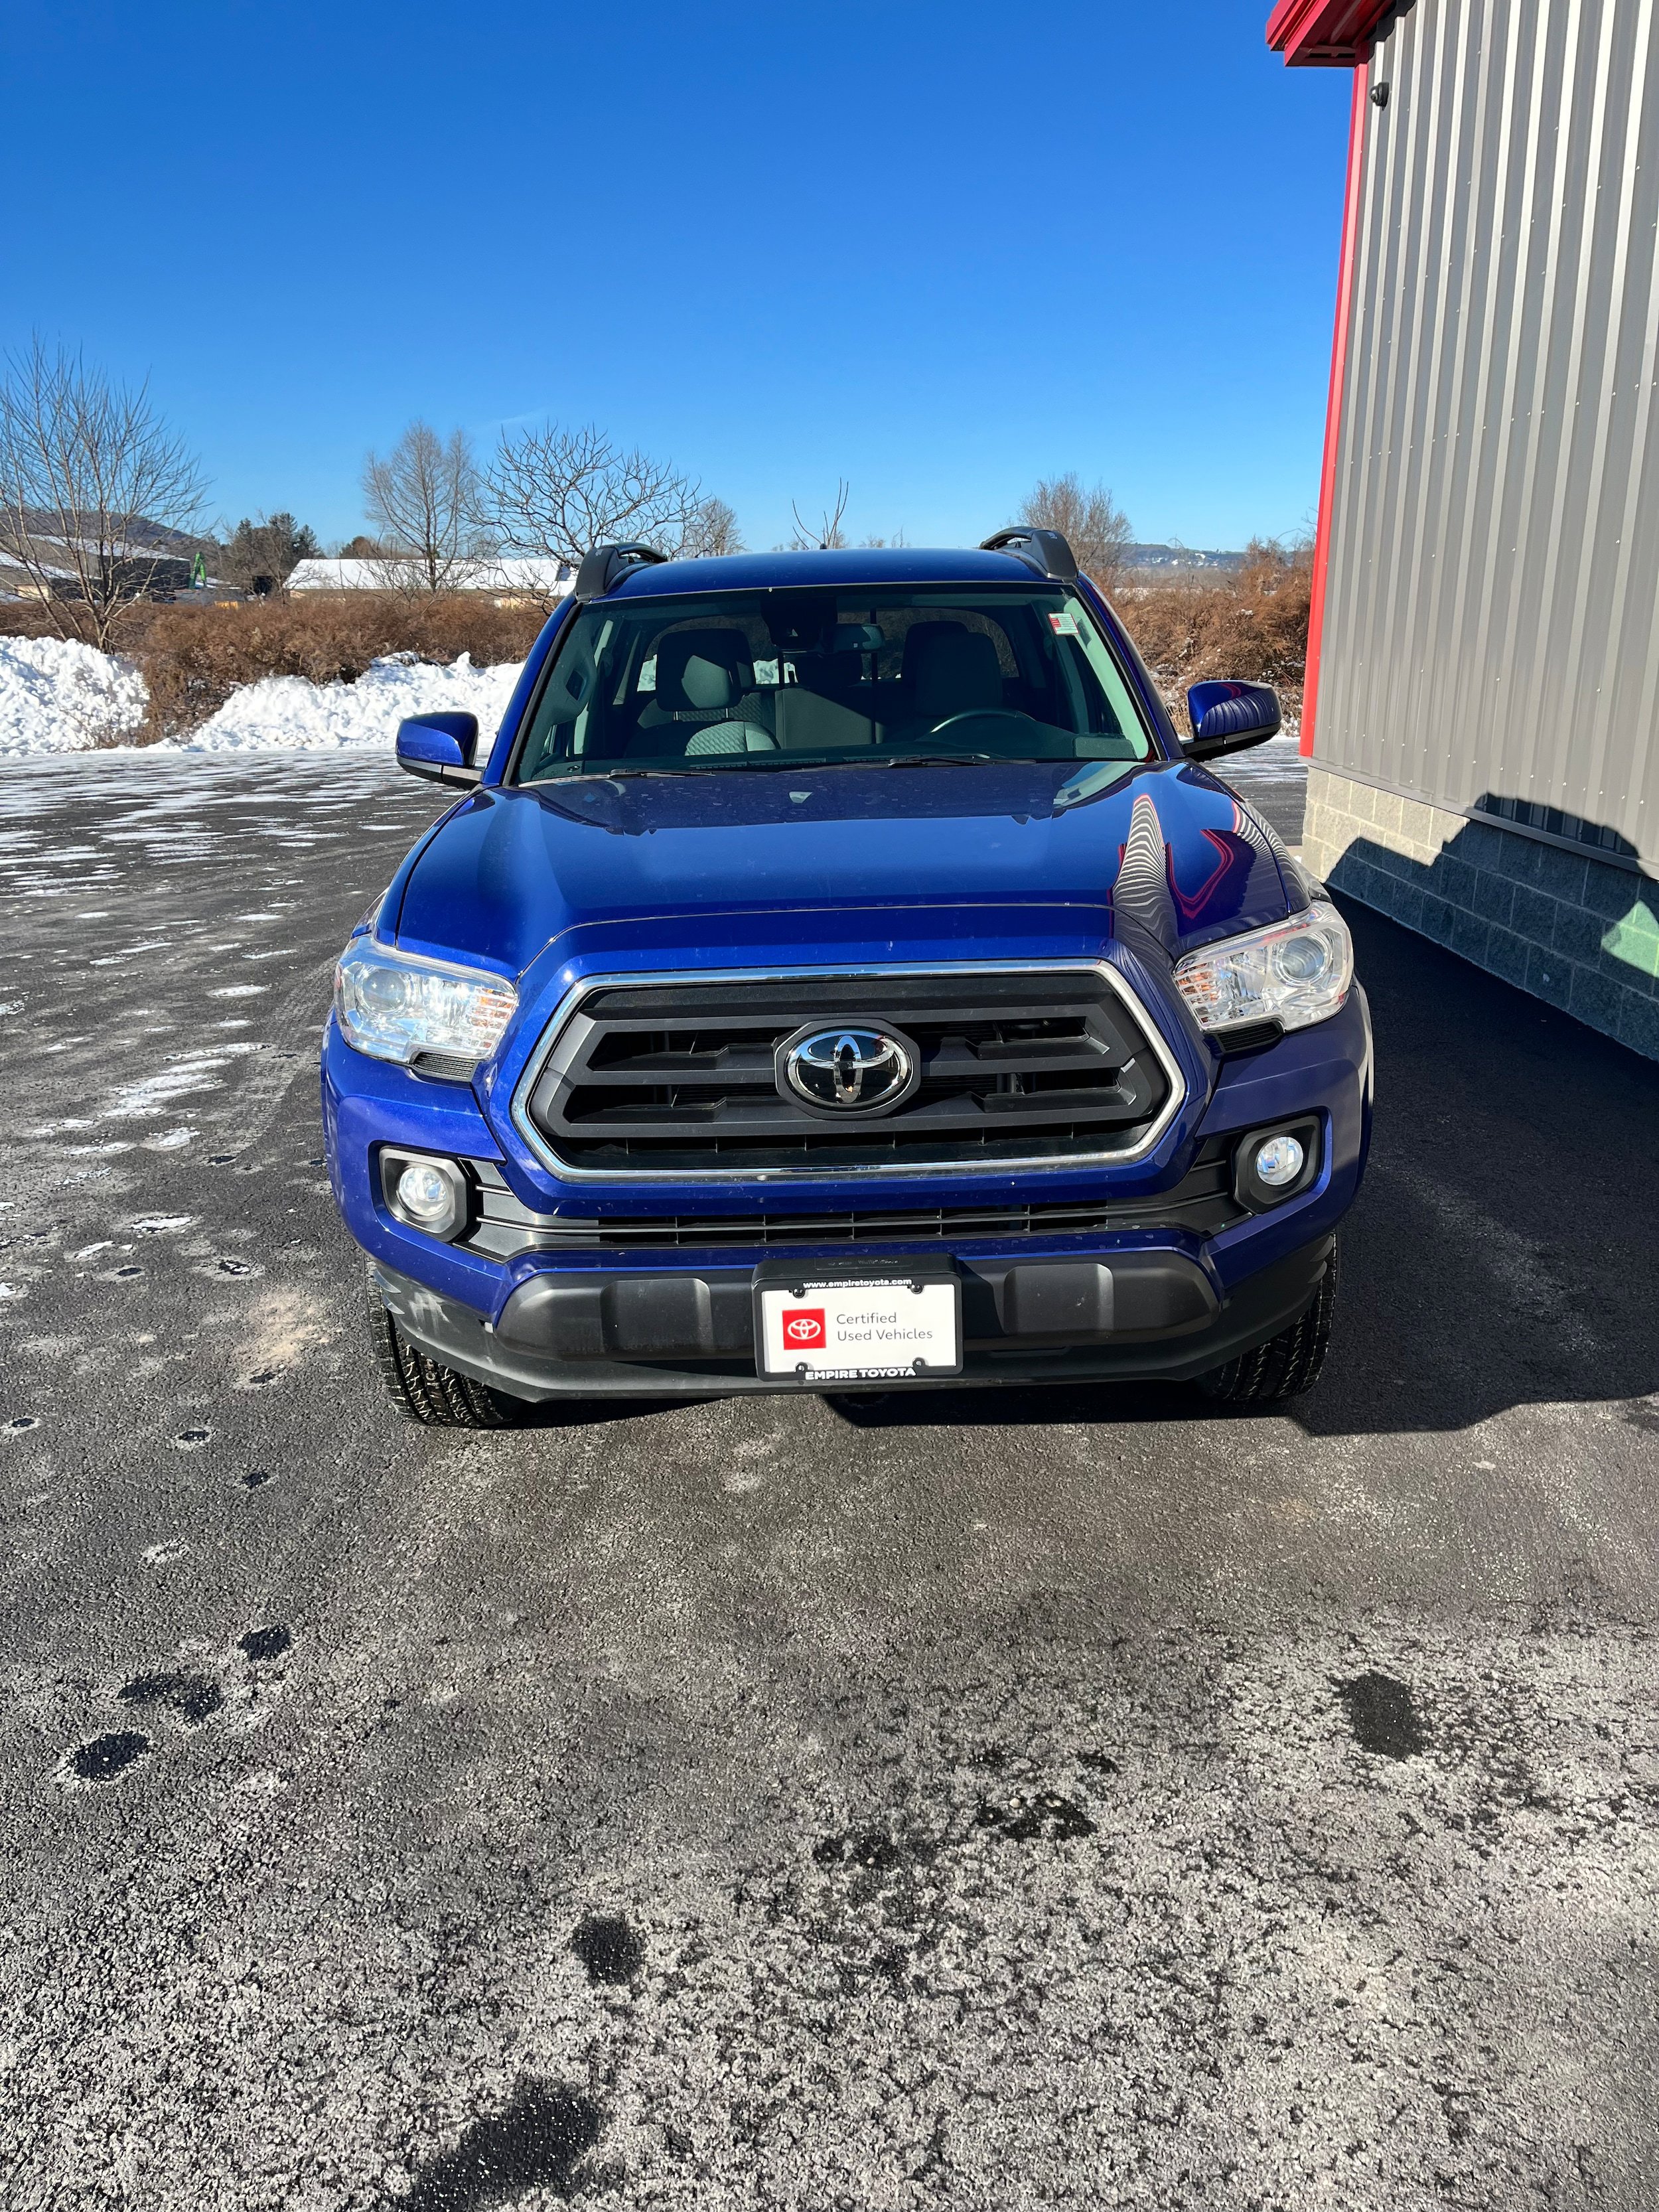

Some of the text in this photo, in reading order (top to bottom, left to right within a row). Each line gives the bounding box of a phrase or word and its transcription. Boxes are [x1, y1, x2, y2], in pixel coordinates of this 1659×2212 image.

[803, 1278, 912, 1289] www.empiretoyota.com
[836, 1311, 897, 1325] Certified
[837, 1328, 933, 1341] Used Vehicles
[805, 1367, 916, 1380] EMPIRE TOYOTA
